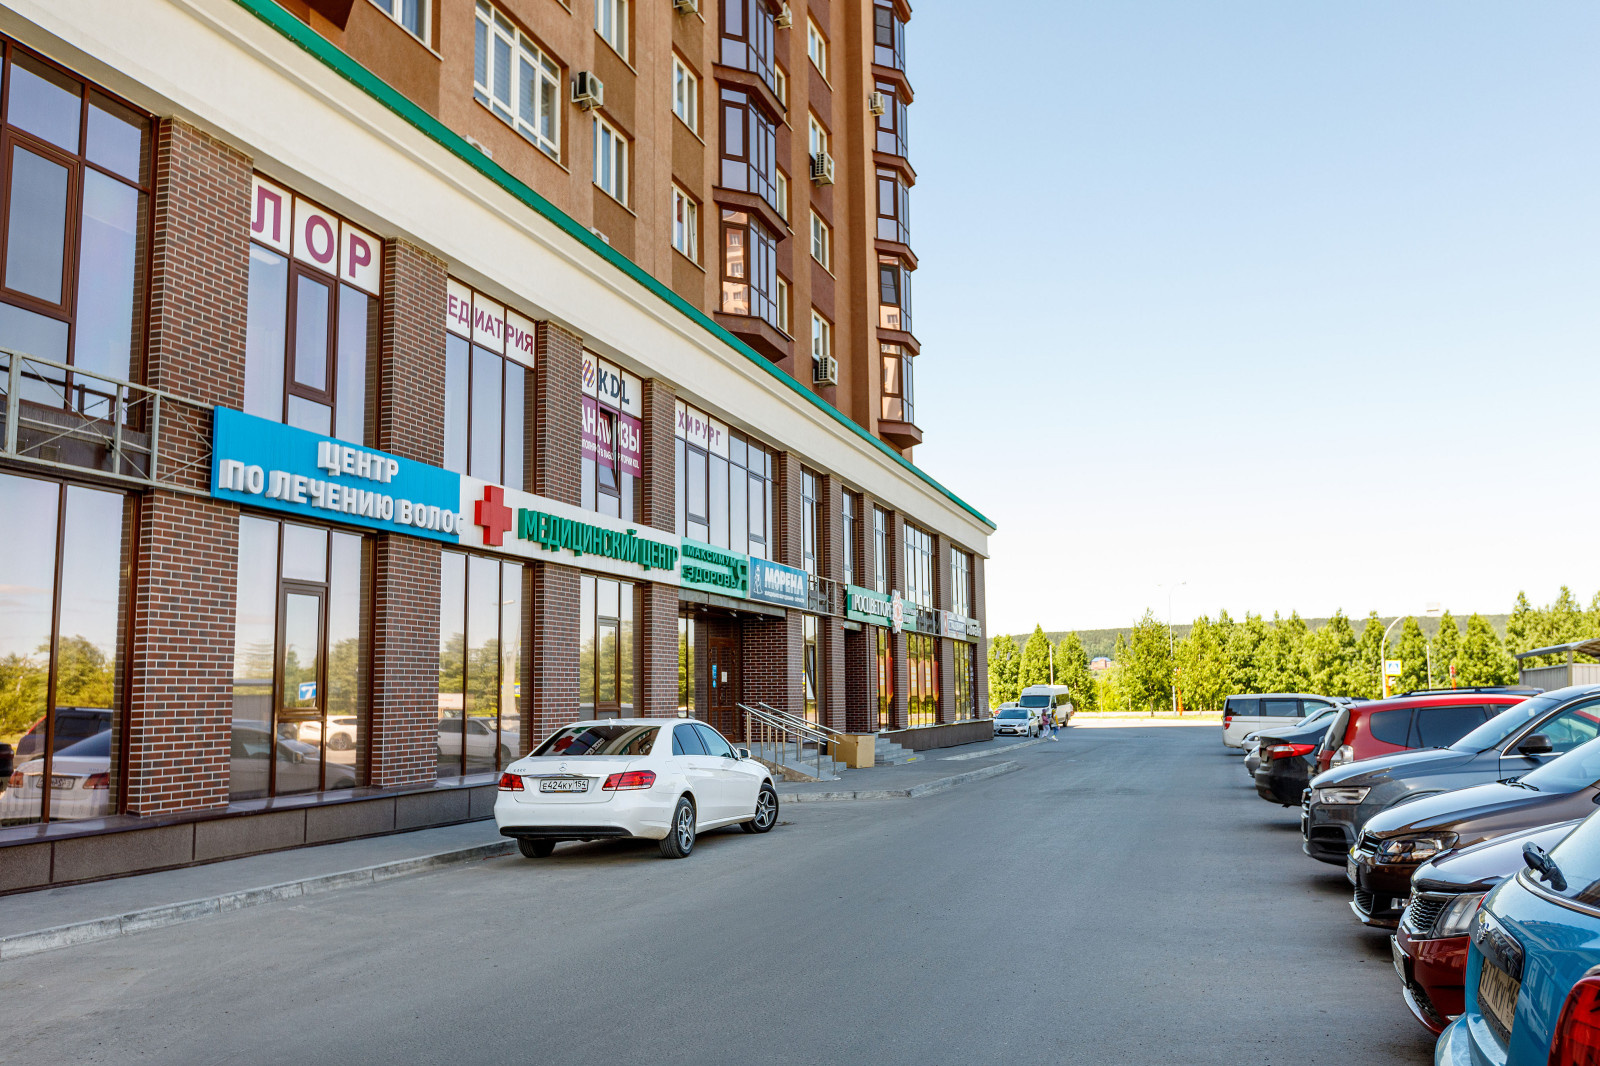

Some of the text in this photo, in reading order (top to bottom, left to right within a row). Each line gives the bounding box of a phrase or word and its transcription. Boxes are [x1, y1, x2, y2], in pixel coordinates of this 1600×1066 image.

[251, 184, 372, 279] ЛОР
[598, 367, 630, 405] KDL
[677, 410, 721, 446] ХИРУРГ
[317, 441, 399, 484] ЦЕНТР
[218, 458, 265, 495] ПО
[265, 469, 394, 521] ЛЕЧЕНИЮ
[518, 507, 680, 571] МЕДИЦИНСКИЙ ЦЕНТР
[682, 544, 739, 568] МАКСИМУМ
[764, 566, 805, 596] МОРЕНА
[574, 780, 586, 788] 154
